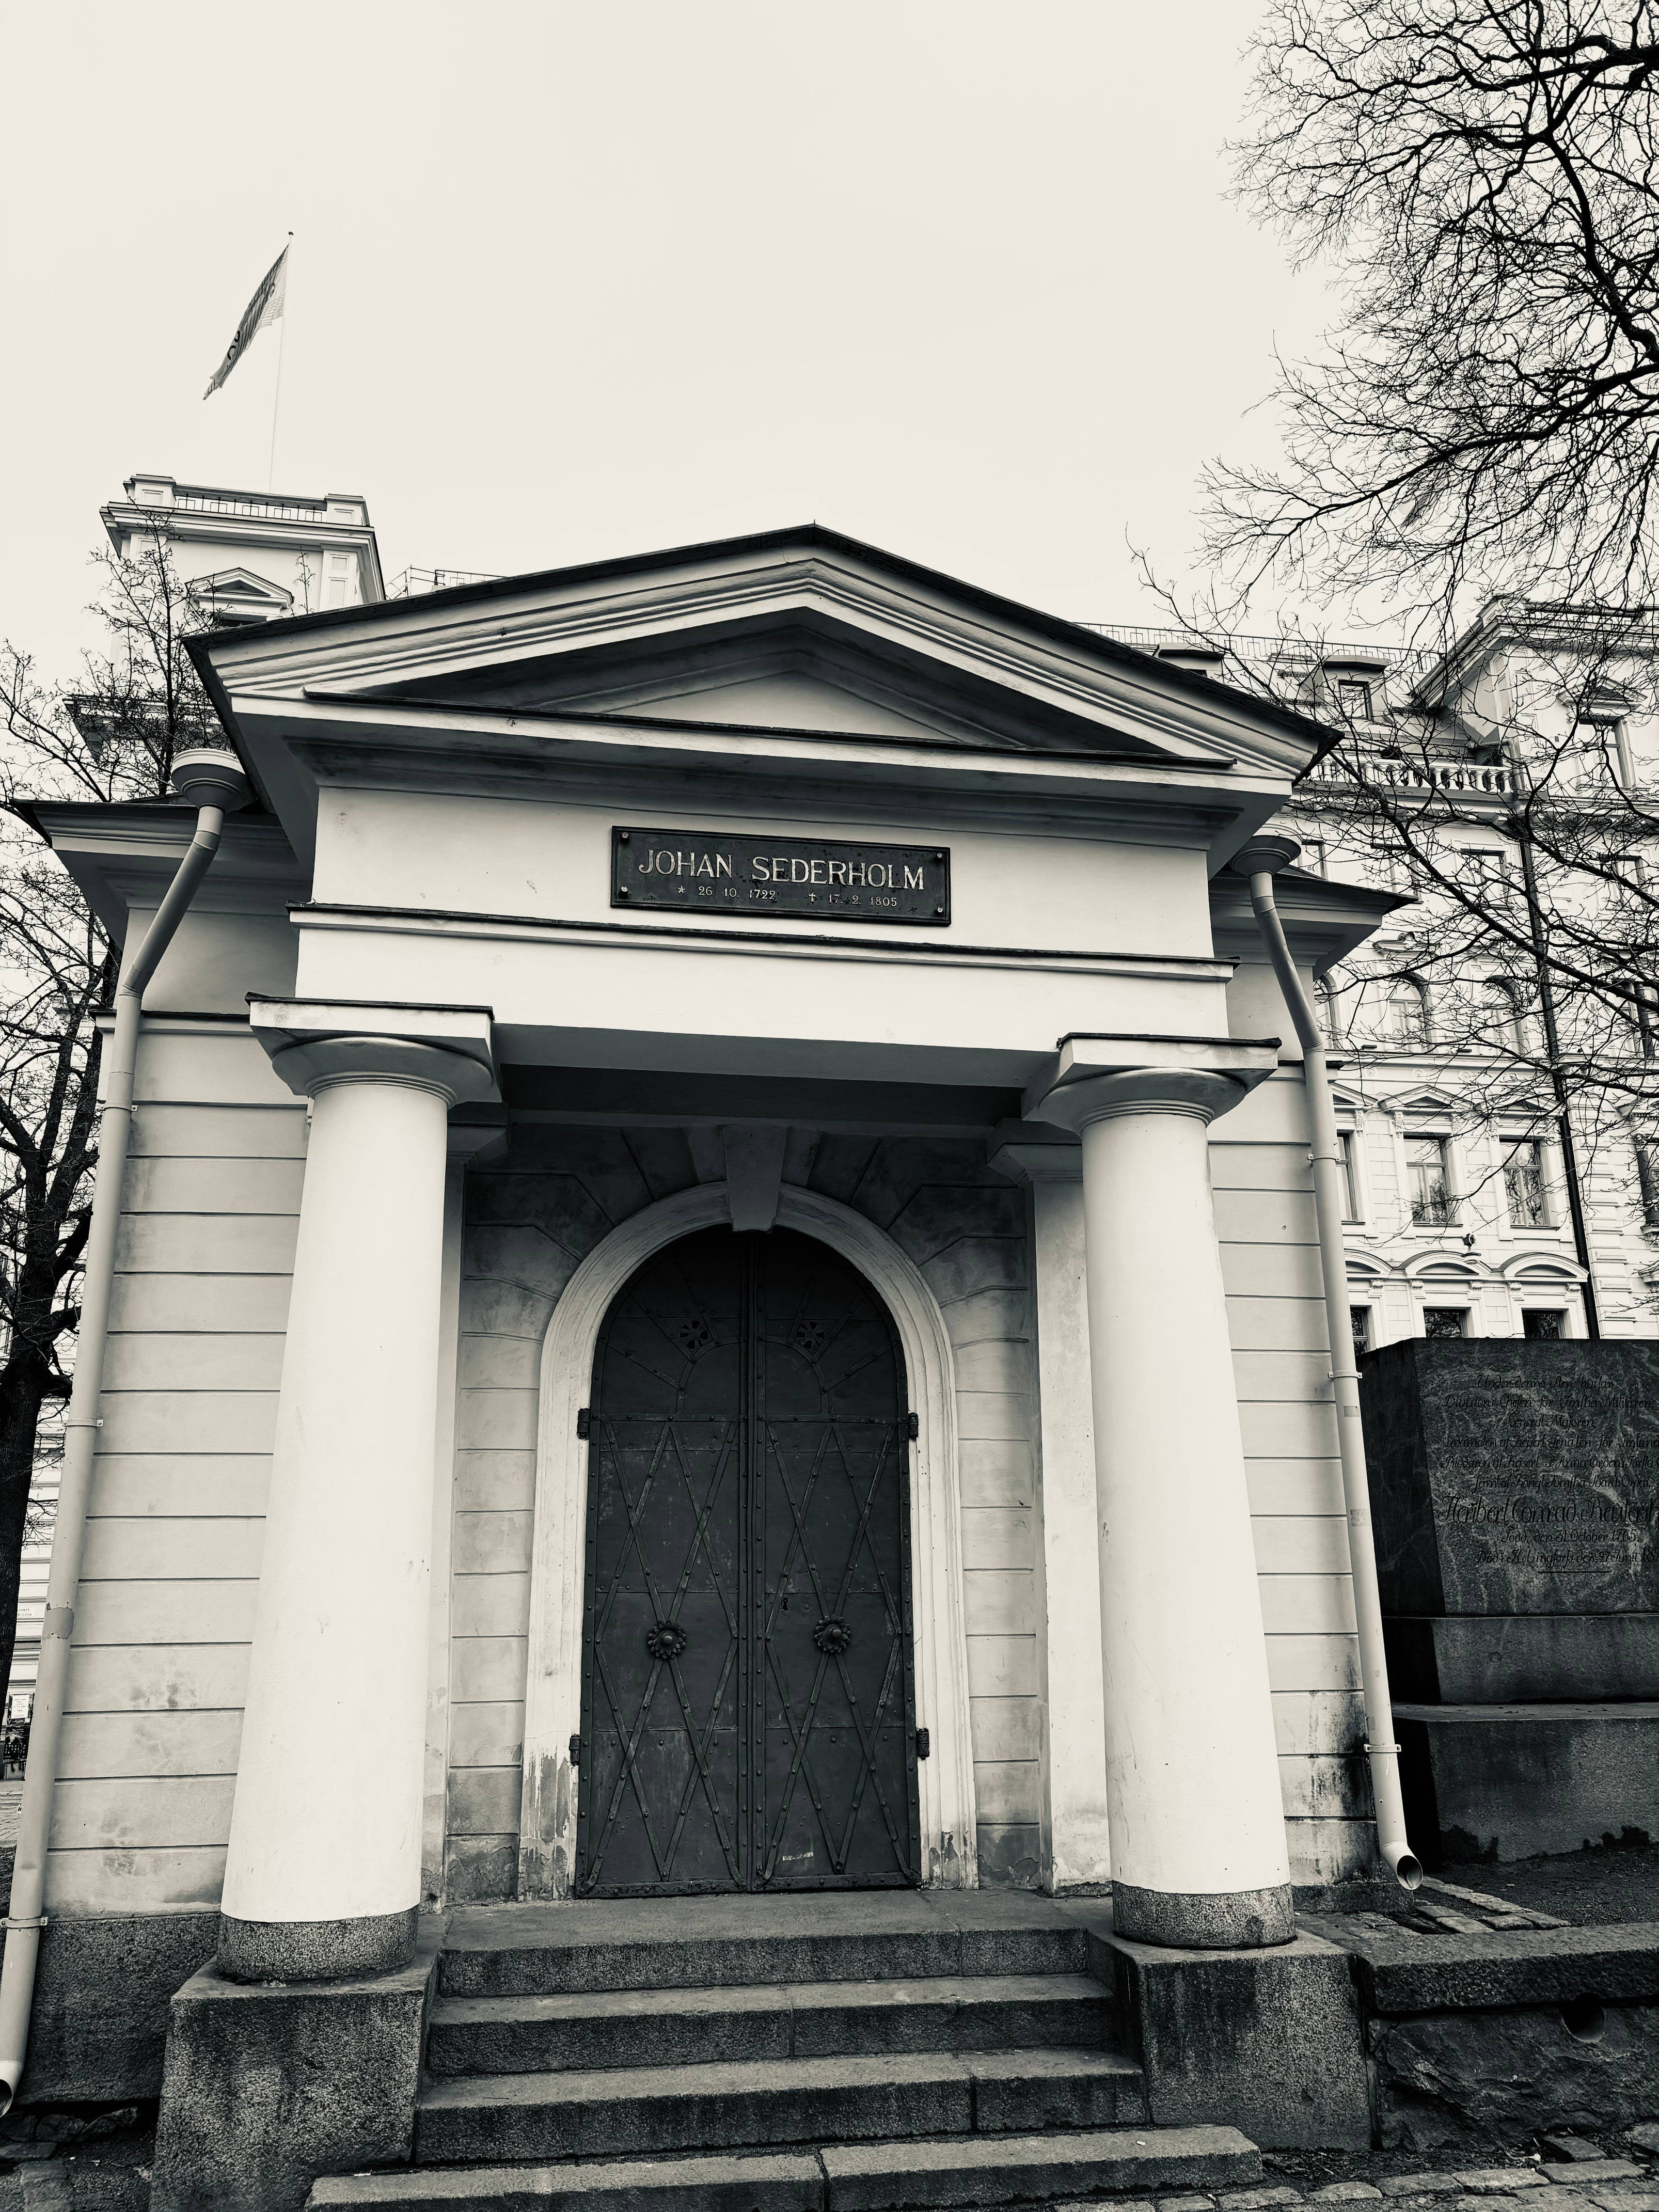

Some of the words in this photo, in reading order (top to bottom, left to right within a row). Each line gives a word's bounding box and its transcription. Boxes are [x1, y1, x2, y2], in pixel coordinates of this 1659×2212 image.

[638, 849, 732, 879] JOHAN
[751, 856, 924, 890] SEDERHOLM
[698, 885, 715, 896] 26.
[724, 888, 739, 898] 10.
[749, 889, 776, 899] 1722
[828, 894, 843, 904] 17.
[852, 895, 861, 905] 2.
[871, 896, 897, 907] 1805
[1477, 1374, 1511, 1388] Under
[1514, 1376, 1547, 1388] denna
[1537, 1395, 1553, 1412] för
[1437, 1495, 1510, 1523] Heribert
[1512, 1497, 1576, 1523] Conrad
[1534, 1529, 1554, 1543] den
[1570, 1529, 1608, 1543] October
